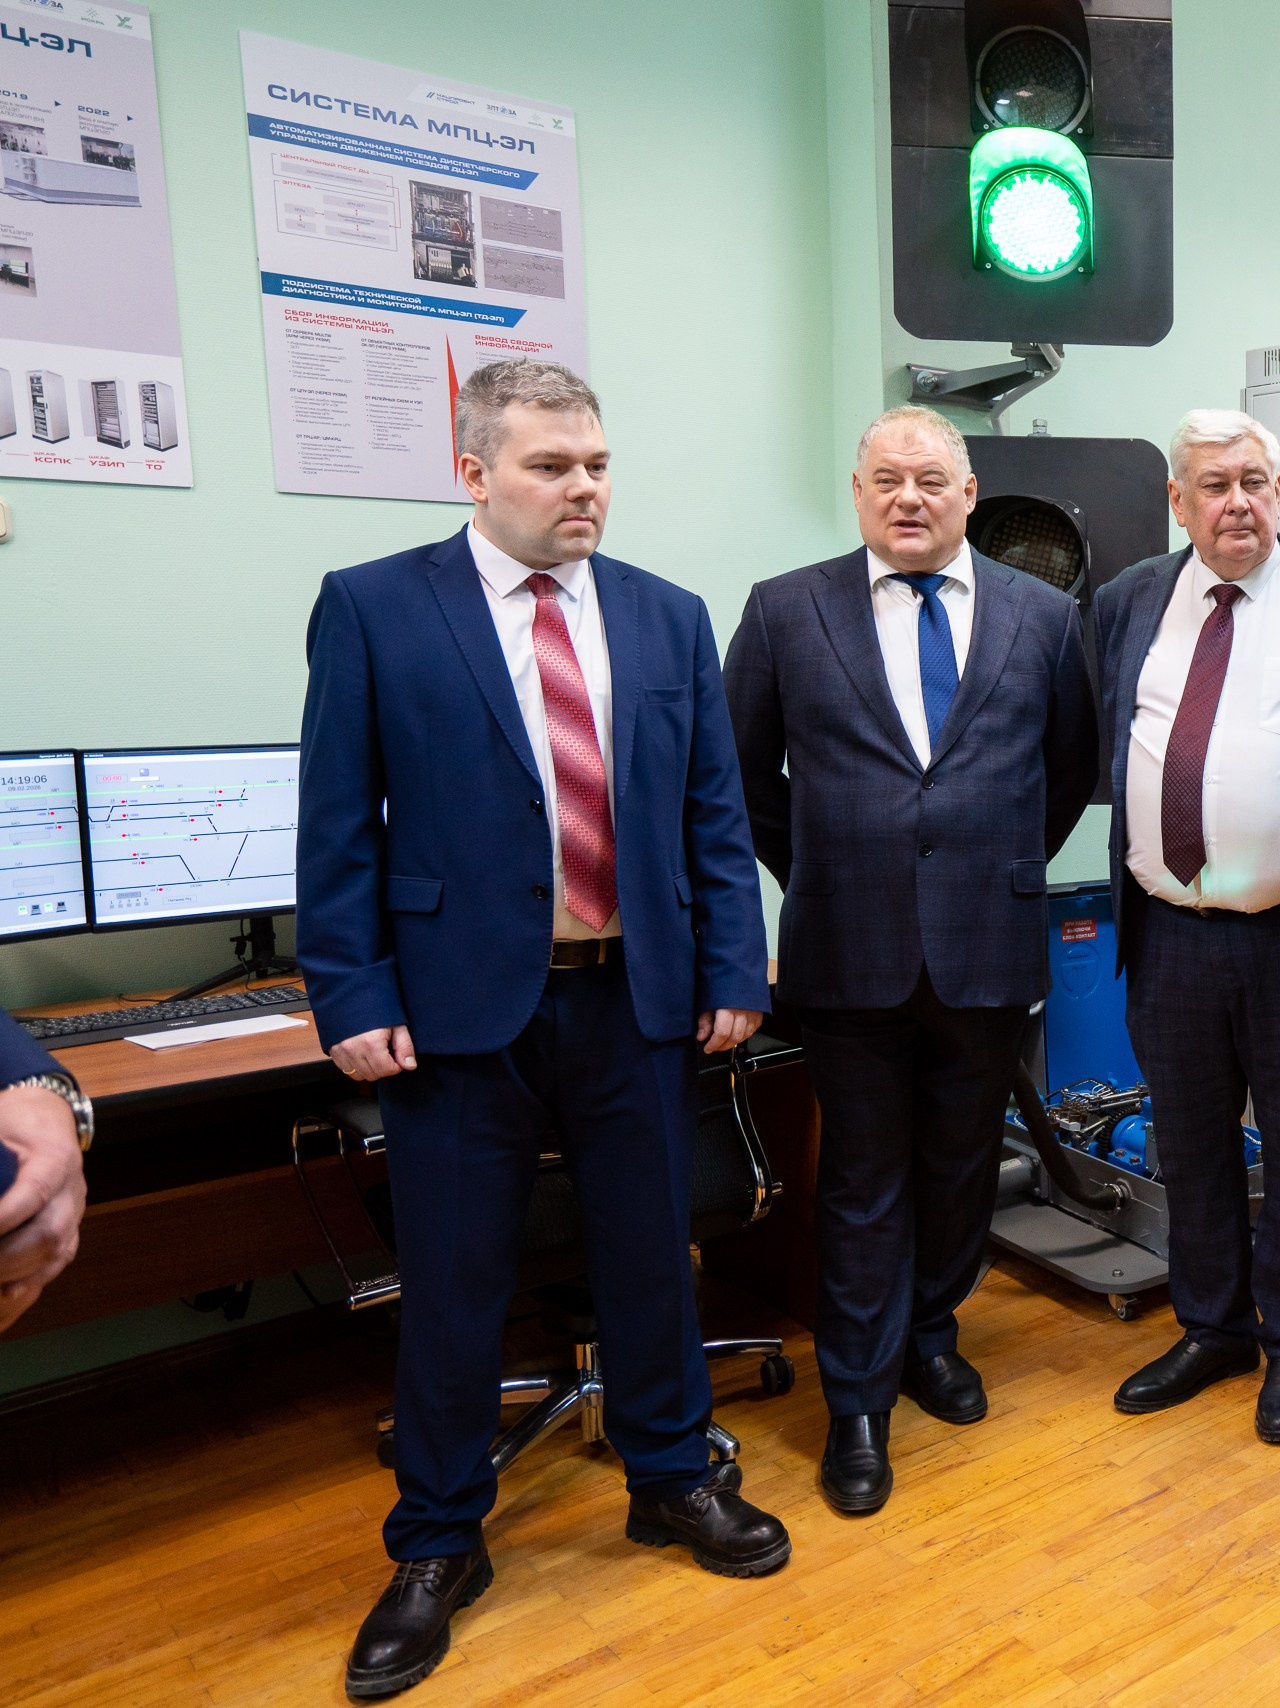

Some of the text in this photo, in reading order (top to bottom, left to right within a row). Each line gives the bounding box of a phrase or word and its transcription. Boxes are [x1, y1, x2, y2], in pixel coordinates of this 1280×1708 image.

[78, 105, 110, 117] 2022
[267, 83, 536, 155] СИСТЕМА МПЦ-ЭЛ
[269, 122, 520, 179] АВТОМАТИЗИРОВАННАЯ СИСТЕМА ДИСПЕТЧЕРСКОГО
[269, 129, 479, 177] УПРАВЛЕНИЯ ДВИЖЕНИЕМ ПОЕЗДОВ ДЦ-ЭЛ
[280, 153, 336, 168] ЦЕНТРАЛЬНЫЙ
[338, 163, 357, 171] ПОСТ
[282, 180, 312, 189] ЭЛТЕЗА
[282, 279, 421, 304] ПОДСИСТЕМА ТЕХНИЧЕСКОЙ
[282, 286, 356, 301] ДИАГНОСТИКИ
[366, 298, 436, 313] МОНИТОРИНГА
[438, 308, 473, 318] МПЦ-ЭЛ
[284, 309, 389, 328] СБОР ИНФОРМАЦИИ
[302, 317, 353, 329] СИСТЕМЫ
[355, 324, 394, 334] МПЦ-ЭЛ
[474, 334, 553, 349] ВЫВОД СВОДНОЙ
[475, 340, 540, 353] ИНФОРМАЦИИ
[34, 456, 72, 465] КСПК
[90, 460, 125, 468] УЗИП
[145, 463, 163, 471] ТО
[1, 774, 48, 785] 14:19:06
